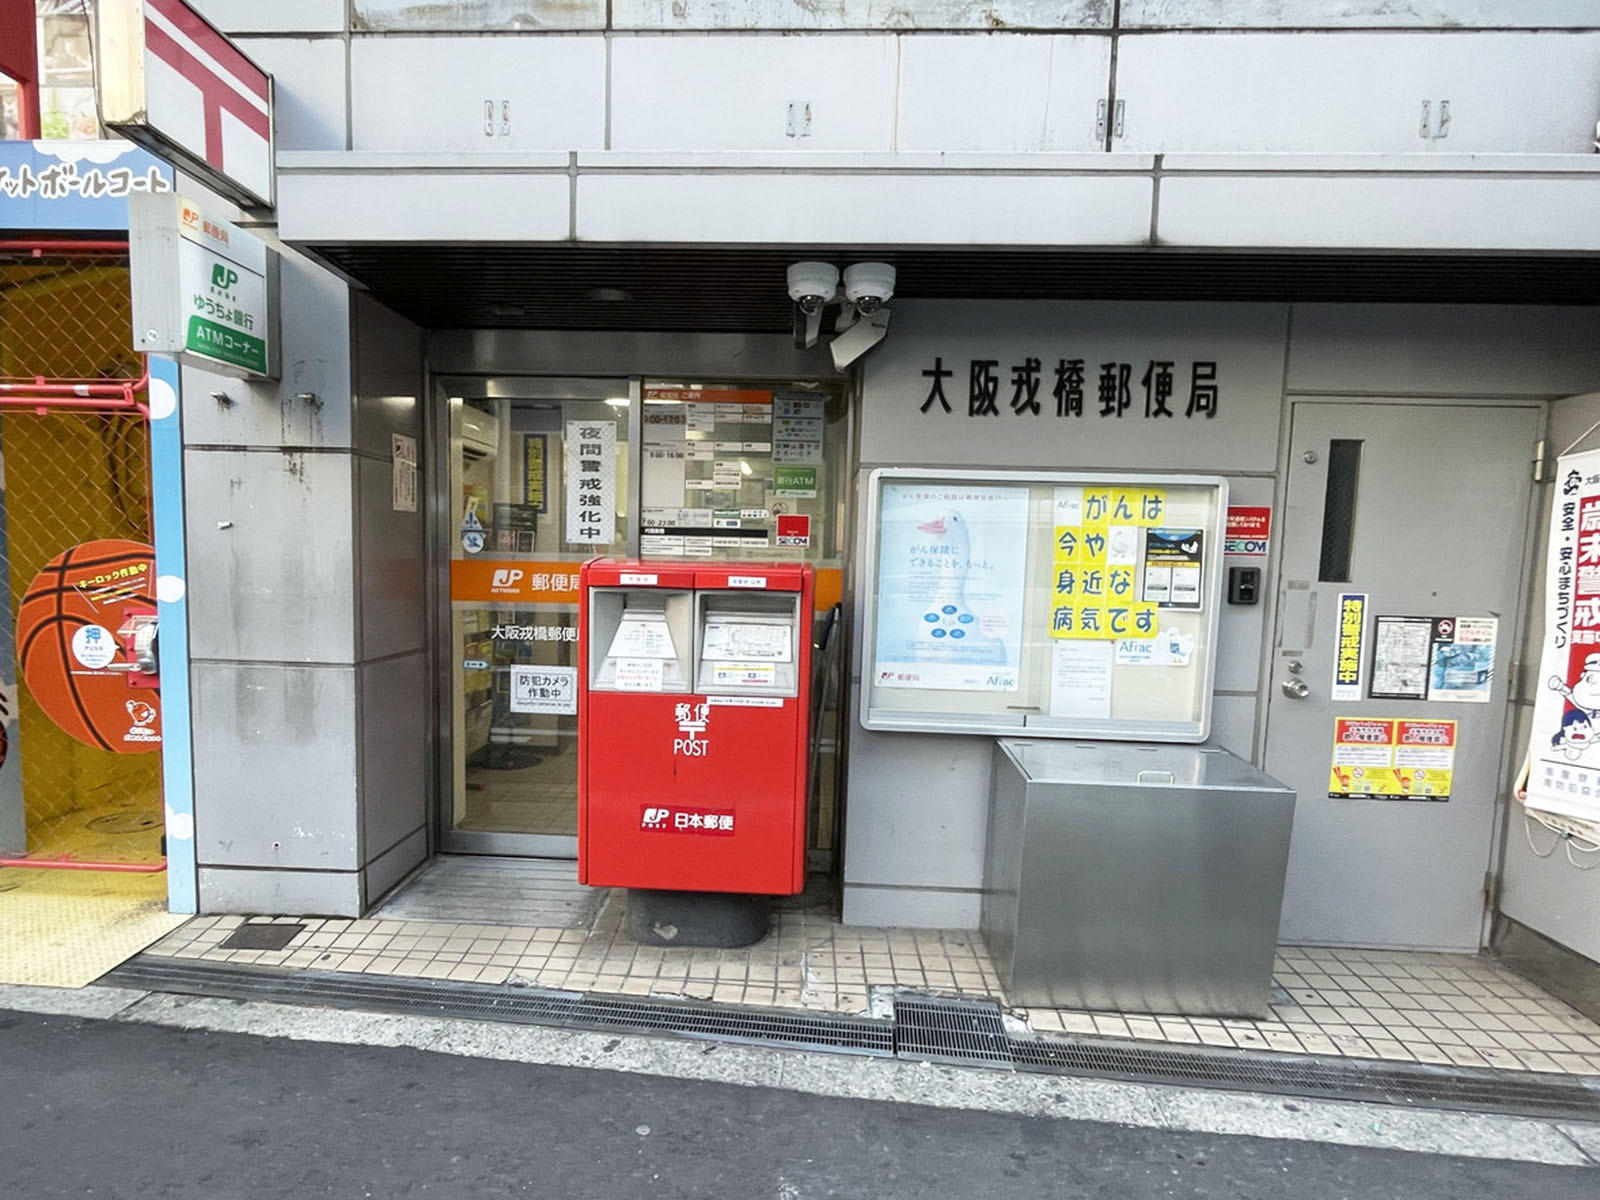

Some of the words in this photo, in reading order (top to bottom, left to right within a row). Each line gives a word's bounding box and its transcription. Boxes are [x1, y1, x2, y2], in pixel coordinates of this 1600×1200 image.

[0, 164, 167, 195] ットボールコート
[194, 294, 253, 331] ゆうちょ銀行
[196, 324, 260, 354] ATMコーナー
[920, 356, 1219, 419] 大阪戎橋郵便局
[578, 426, 603, 540] 夜間警戒強化中
[1085, 493, 1163, 521] がんは
[1058, 530, 1106, 557] 今や
[491, 568, 524, 588] JP
[1056, 569, 1131, 595] 身近な
[1554, 501, 1576, 650] 安全・安心まちづくり
[1052, 605, 1156, 634] 病気です
[490, 624, 579, 642] 大阪戎橋郵便
[519, 674, 569, 687] 防犯カメラ
[527, 687, 562, 699] 作動中
[674, 702, 711, 723] 郵便
[673, 738, 710, 757] POST
[643, 808, 670, 824] JP
[674, 812, 734, 831] 日本郵便
